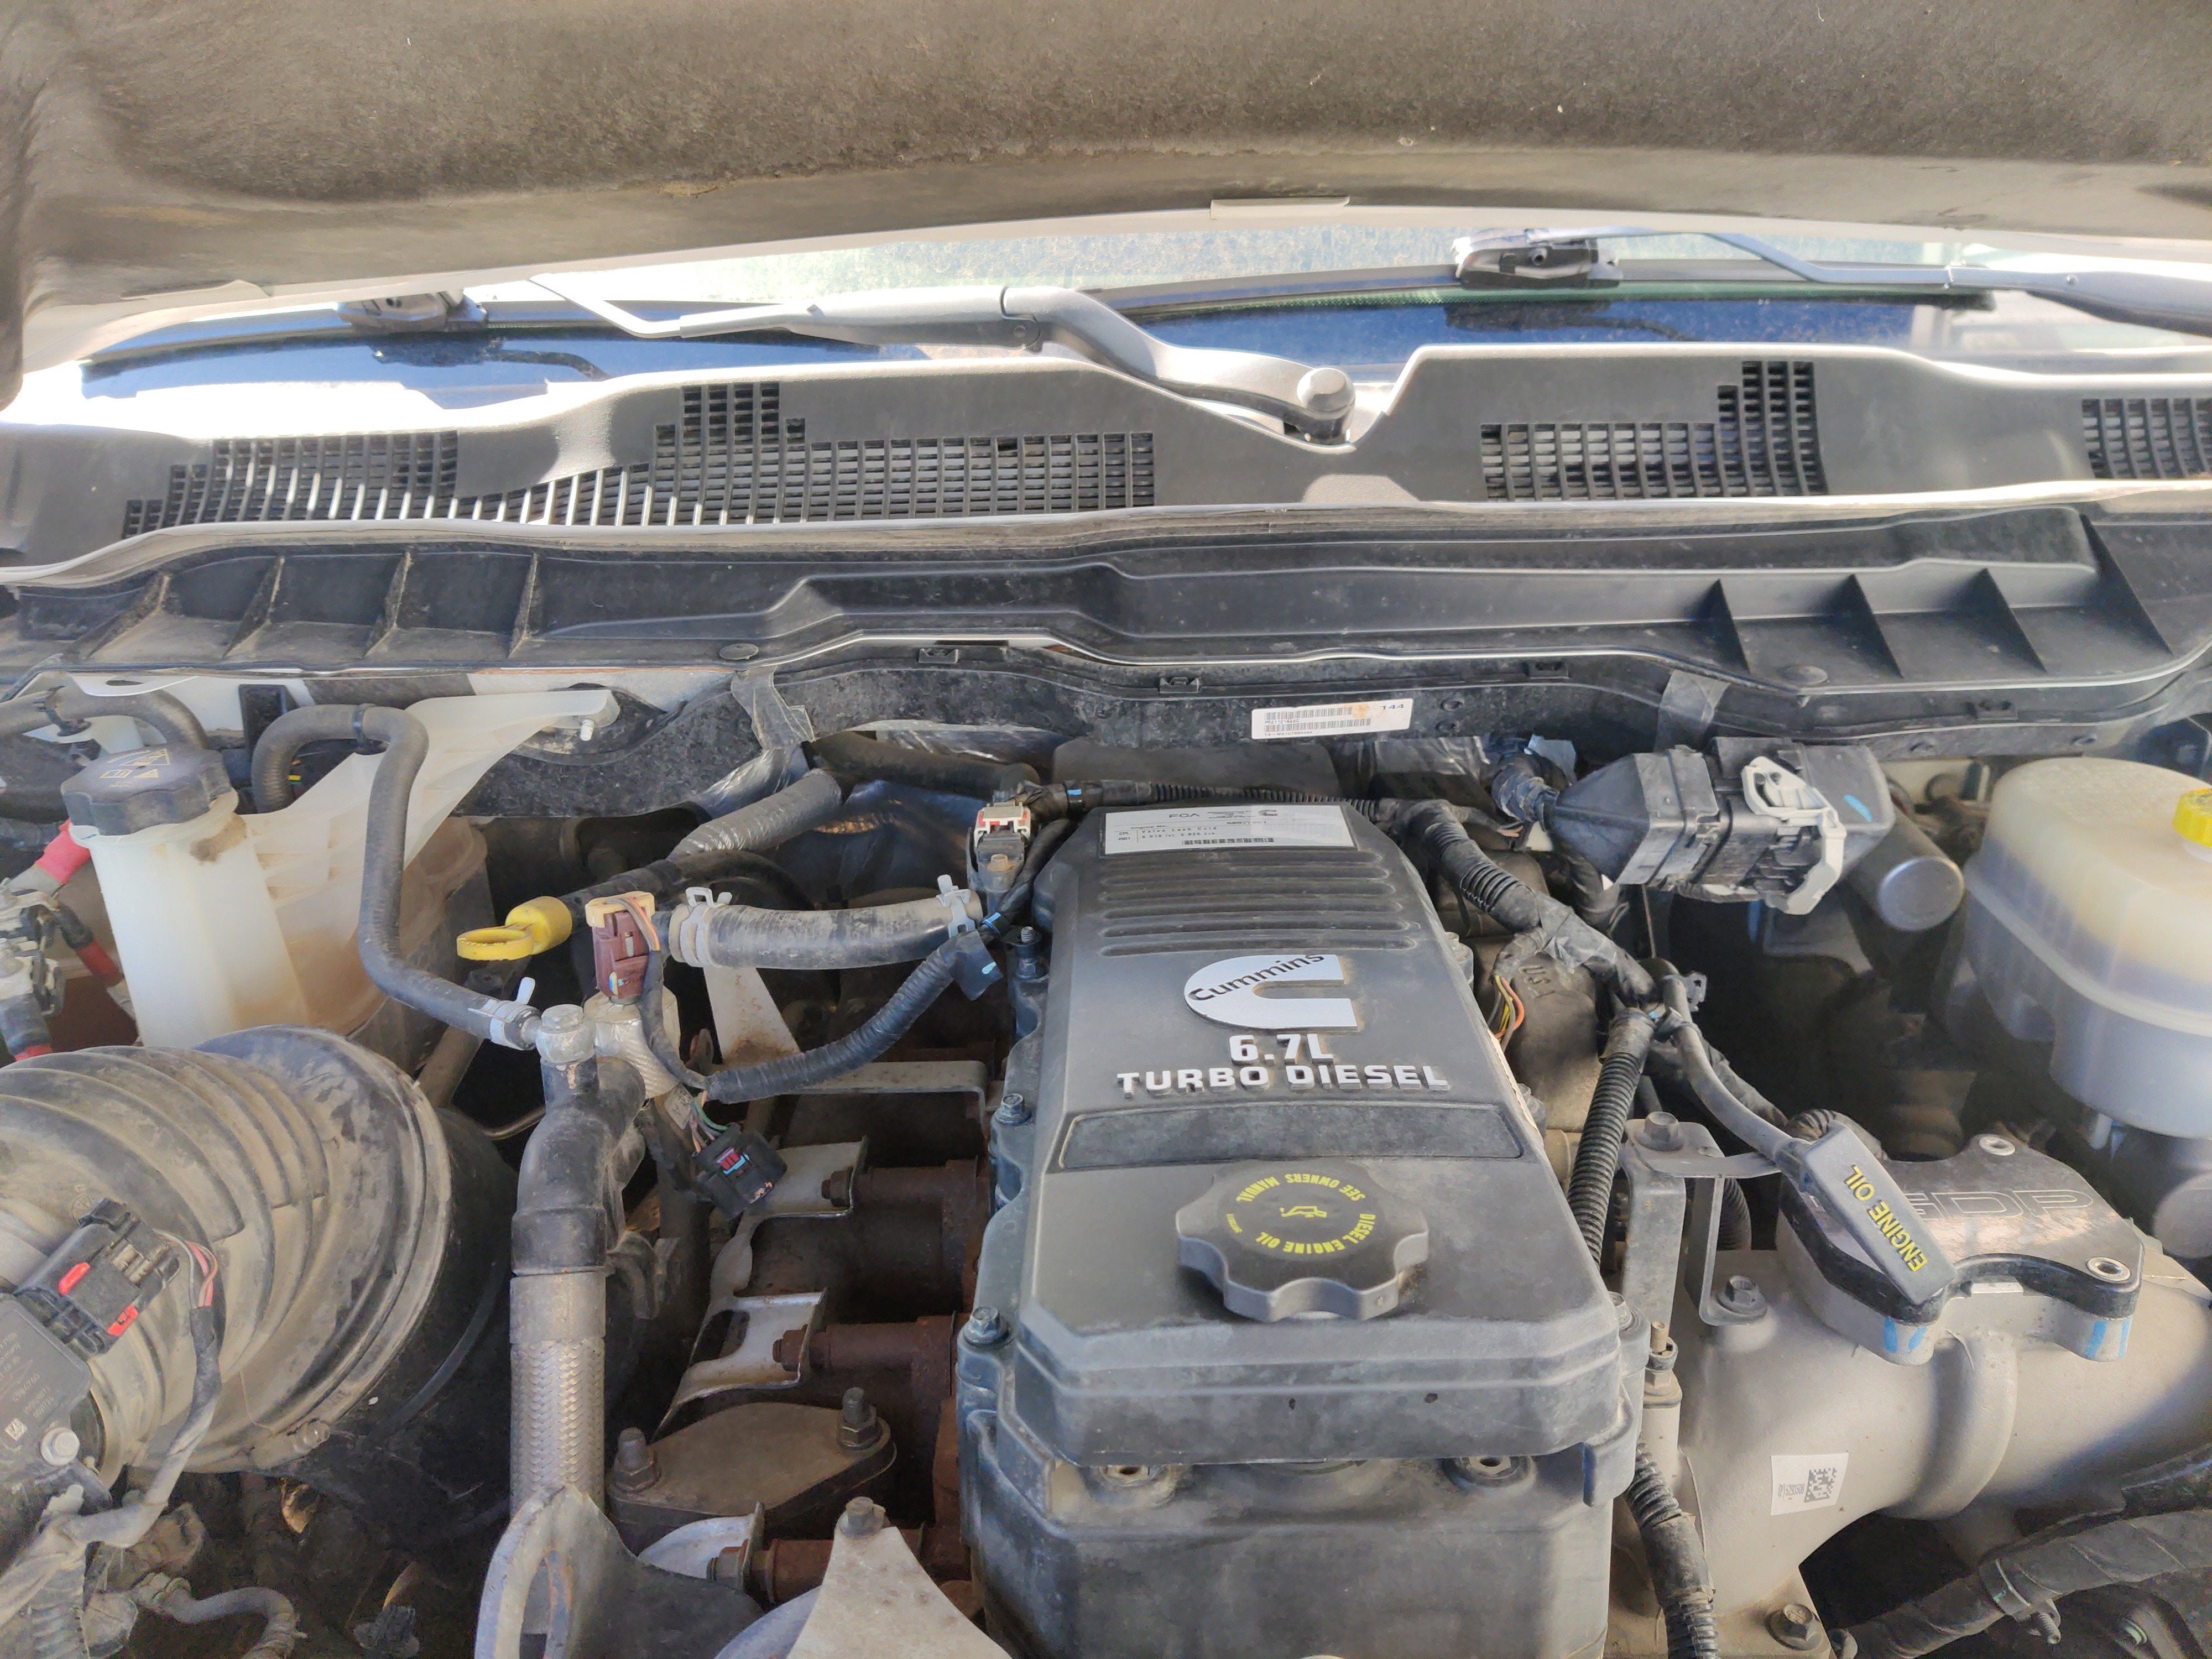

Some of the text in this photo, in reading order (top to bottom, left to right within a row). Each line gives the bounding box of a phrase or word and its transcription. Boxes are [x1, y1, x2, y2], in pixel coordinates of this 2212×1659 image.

[1188, 952, 1325, 1001] Cummins
[1229, 1033, 1334, 1065] 6.7L
[1117, 1065, 1451, 1098] TURBO DIESEL
[1236, 1173, 1366, 1203] SEE OWNERS MANUAL
[1255, 1213, 1376, 1255] DIESEL ENGINE OIL
[1843, 1164, 1928, 1272] ENGINE OIL
